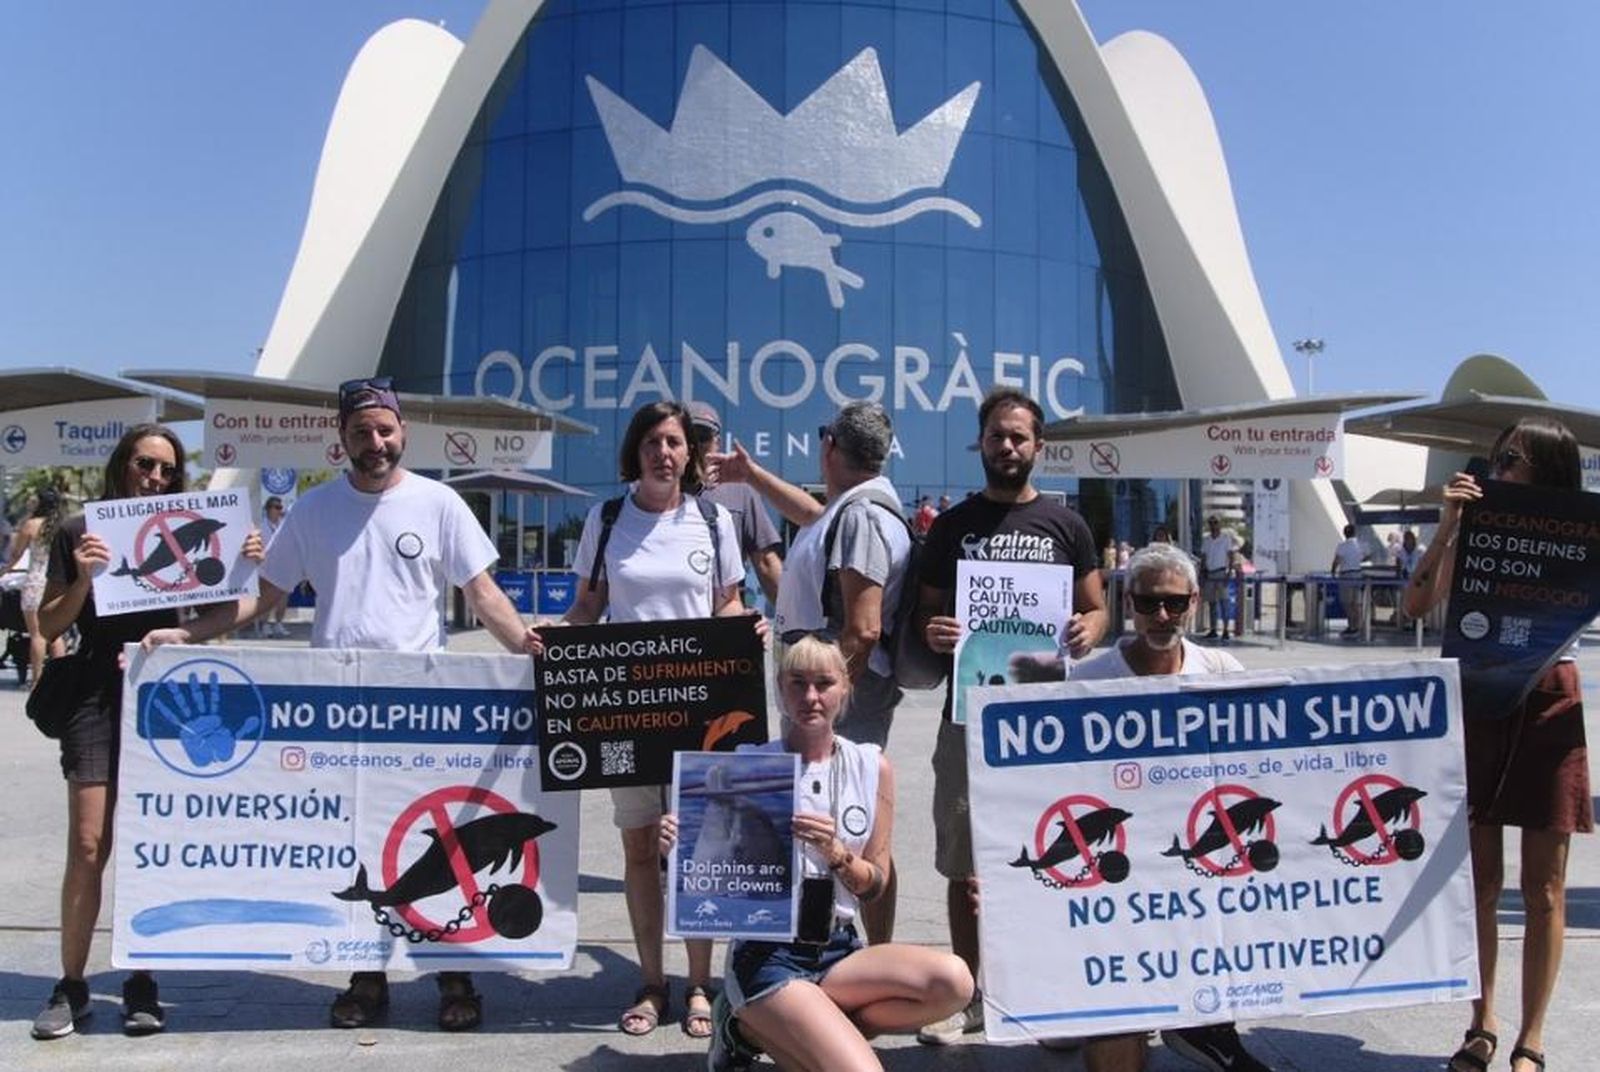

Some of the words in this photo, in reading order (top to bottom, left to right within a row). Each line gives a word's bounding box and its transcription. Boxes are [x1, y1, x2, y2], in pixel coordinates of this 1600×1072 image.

[474, 332, 1085, 419] OCEANOGRÀFIC
[213, 412, 248, 429] Con
[255, 414, 272, 429] tu
[279, 413, 340, 429] entrad
[55, 420, 131, 442] Taquill
[1207, 425, 1241, 441] Con
[1248, 427, 1264, 442] tu
[1270, 427, 1337, 442] entrada
[494, 435, 524, 452] NO
[1045, 445, 1074, 461] NO
[97, 507, 116, 521] SU
[119, 502, 165, 519] LUGAR
[168, 500, 184, 513] ES
[188, 498, 204, 510] EL
[206, 493, 239, 509] MAR
[989, 530, 1054, 550] anima
[1468, 532, 1501, 550] LOS
[1506, 536, 1588, 562] DELFINES
[990, 548, 1055, 563] naturalis
[1465, 554, 1496, 572] NO
[1501, 558, 1541, 578] SON
[969, 575, 995, 590] NO
[999, 577, 1015, 591] TE
[1462, 577, 1489, 594] UN
[969, 589, 1040, 608] CAUTIVES
[968, 604, 999, 619] POR
[1004, 606, 1021, 620] LA
[968, 618, 1057, 638] CAUTIVIDAD
[544, 667, 599, 686] BASTA
[604, 666, 627, 683] DE
[545, 692, 576, 710] NO
[582, 687, 622, 708] MÁS
[627, 684, 709, 706] DELFINES
[271, 700, 315, 730] NO
[326, 702, 462, 732] DOLPHIN
[472, 704, 538, 733] SHO
[547, 718, 571, 735] EN
[577, 710, 689, 734] CAUTIVERIO!
[998, 714, 1065, 759] NO
[1082, 698, 1287, 753] DOLPHIN
[1304, 681, 1436, 741] SHOW
[310, 752, 535, 771] @oceanos_de_vida_libre
[1148, 752, 1388, 785] @oceanos_de_vida_libre
[135, 792, 173, 817] TU
[134, 842, 170, 869] SU
[181, 843, 357, 870] CAUTIVERIO
[681, 859, 755, 879] Dolphins
[759, 865, 786, 876] are
[683, 876, 722, 892] NOT
[727, 879, 783, 893] clowns
[1068, 895, 1116, 929] NO
[1128, 887, 1207, 924] SEAS
[1217, 875, 1384, 915] CÓMPLICE
[1084, 955, 1127, 986] DE
[1137, 949, 1179, 983] SU
[1190, 933, 1385, 977] CAUTIVERIO
